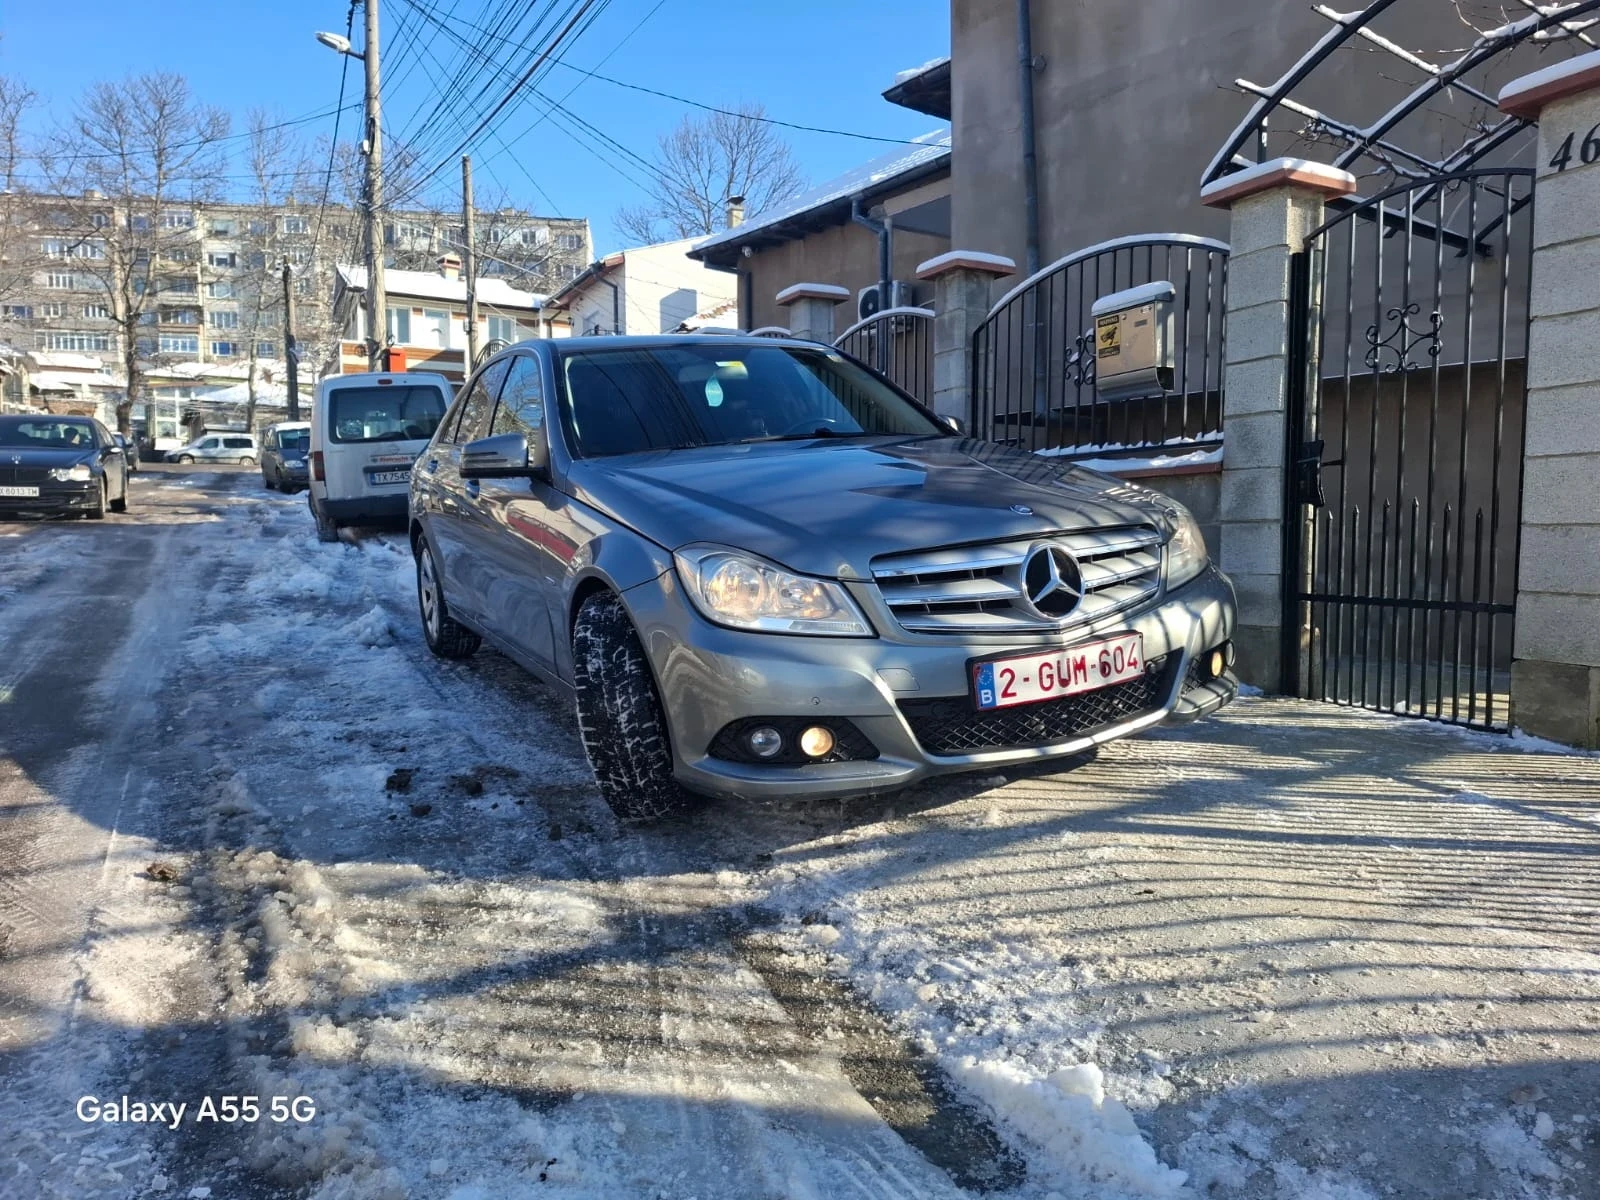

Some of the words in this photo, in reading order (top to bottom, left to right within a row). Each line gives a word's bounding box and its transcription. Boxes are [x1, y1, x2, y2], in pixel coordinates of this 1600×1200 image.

[1549, 122, 1600, 171] 46
[981, 689, 993, 704] B
[999, 642, 1138, 699] 2-GUM-604
